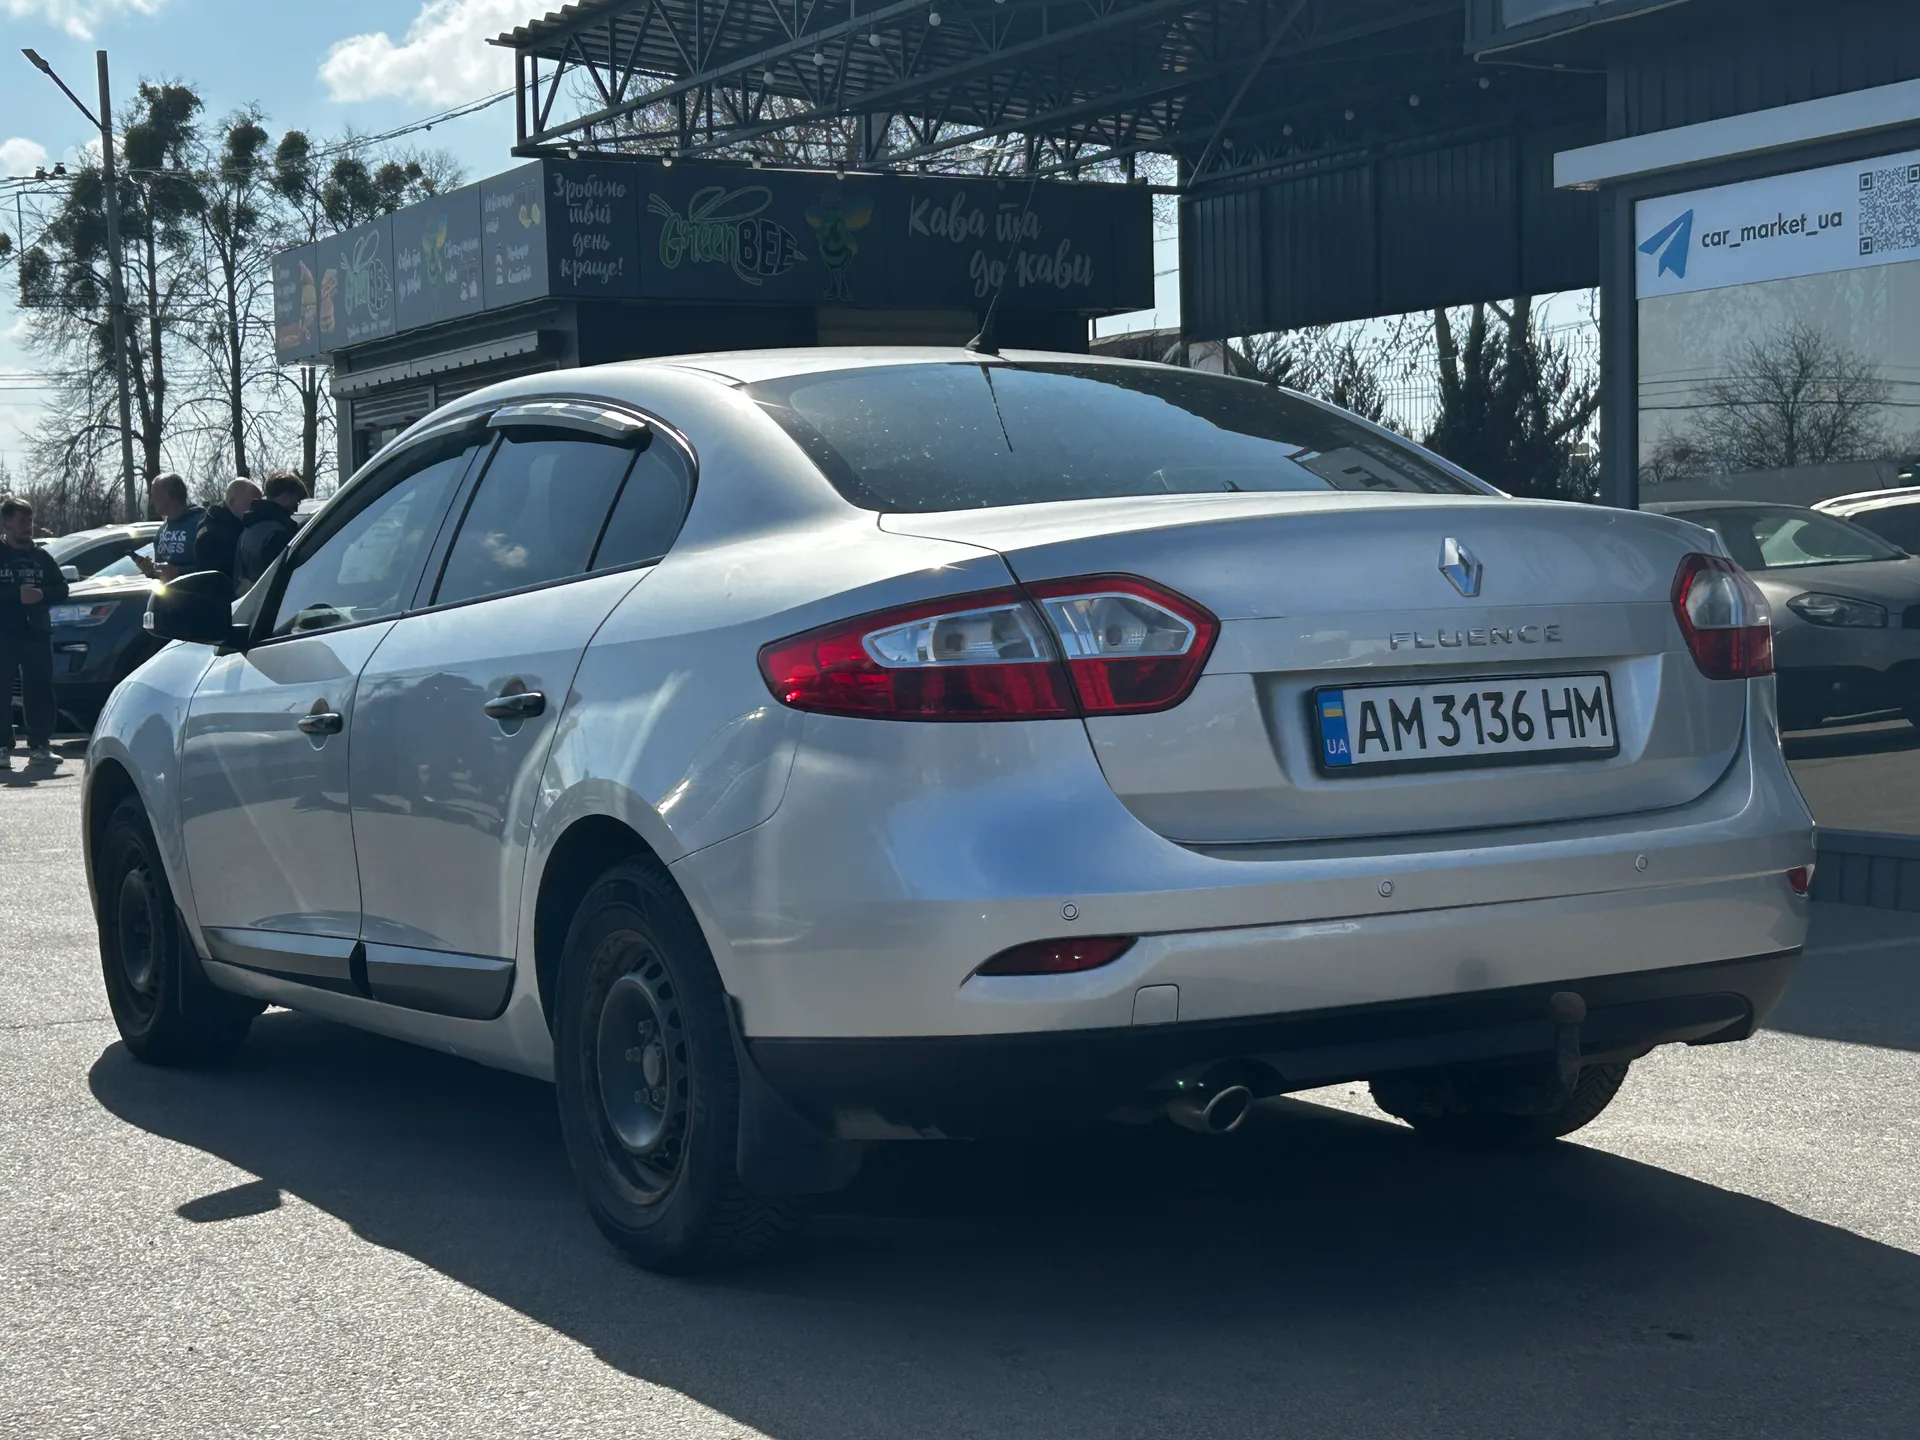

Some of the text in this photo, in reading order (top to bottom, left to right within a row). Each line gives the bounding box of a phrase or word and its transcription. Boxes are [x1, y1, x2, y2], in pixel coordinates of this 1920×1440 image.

[553, 173, 627, 204] Зробимо
[569, 198, 612, 225] твій
[908, 191, 1043, 243] Кава та
[1701, 211, 1843, 248] car_market_ua
[572, 231, 612, 257] день
[560, 257, 624, 287] краще!
[969, 238, 1095, 298] до кави
[157, 542, 185, 554] ONES
[159, 530, 187, 543] ACK&
[1389, 624, 1563, 650] FLUENCE
[1326, 738, 1348, 755] UA
